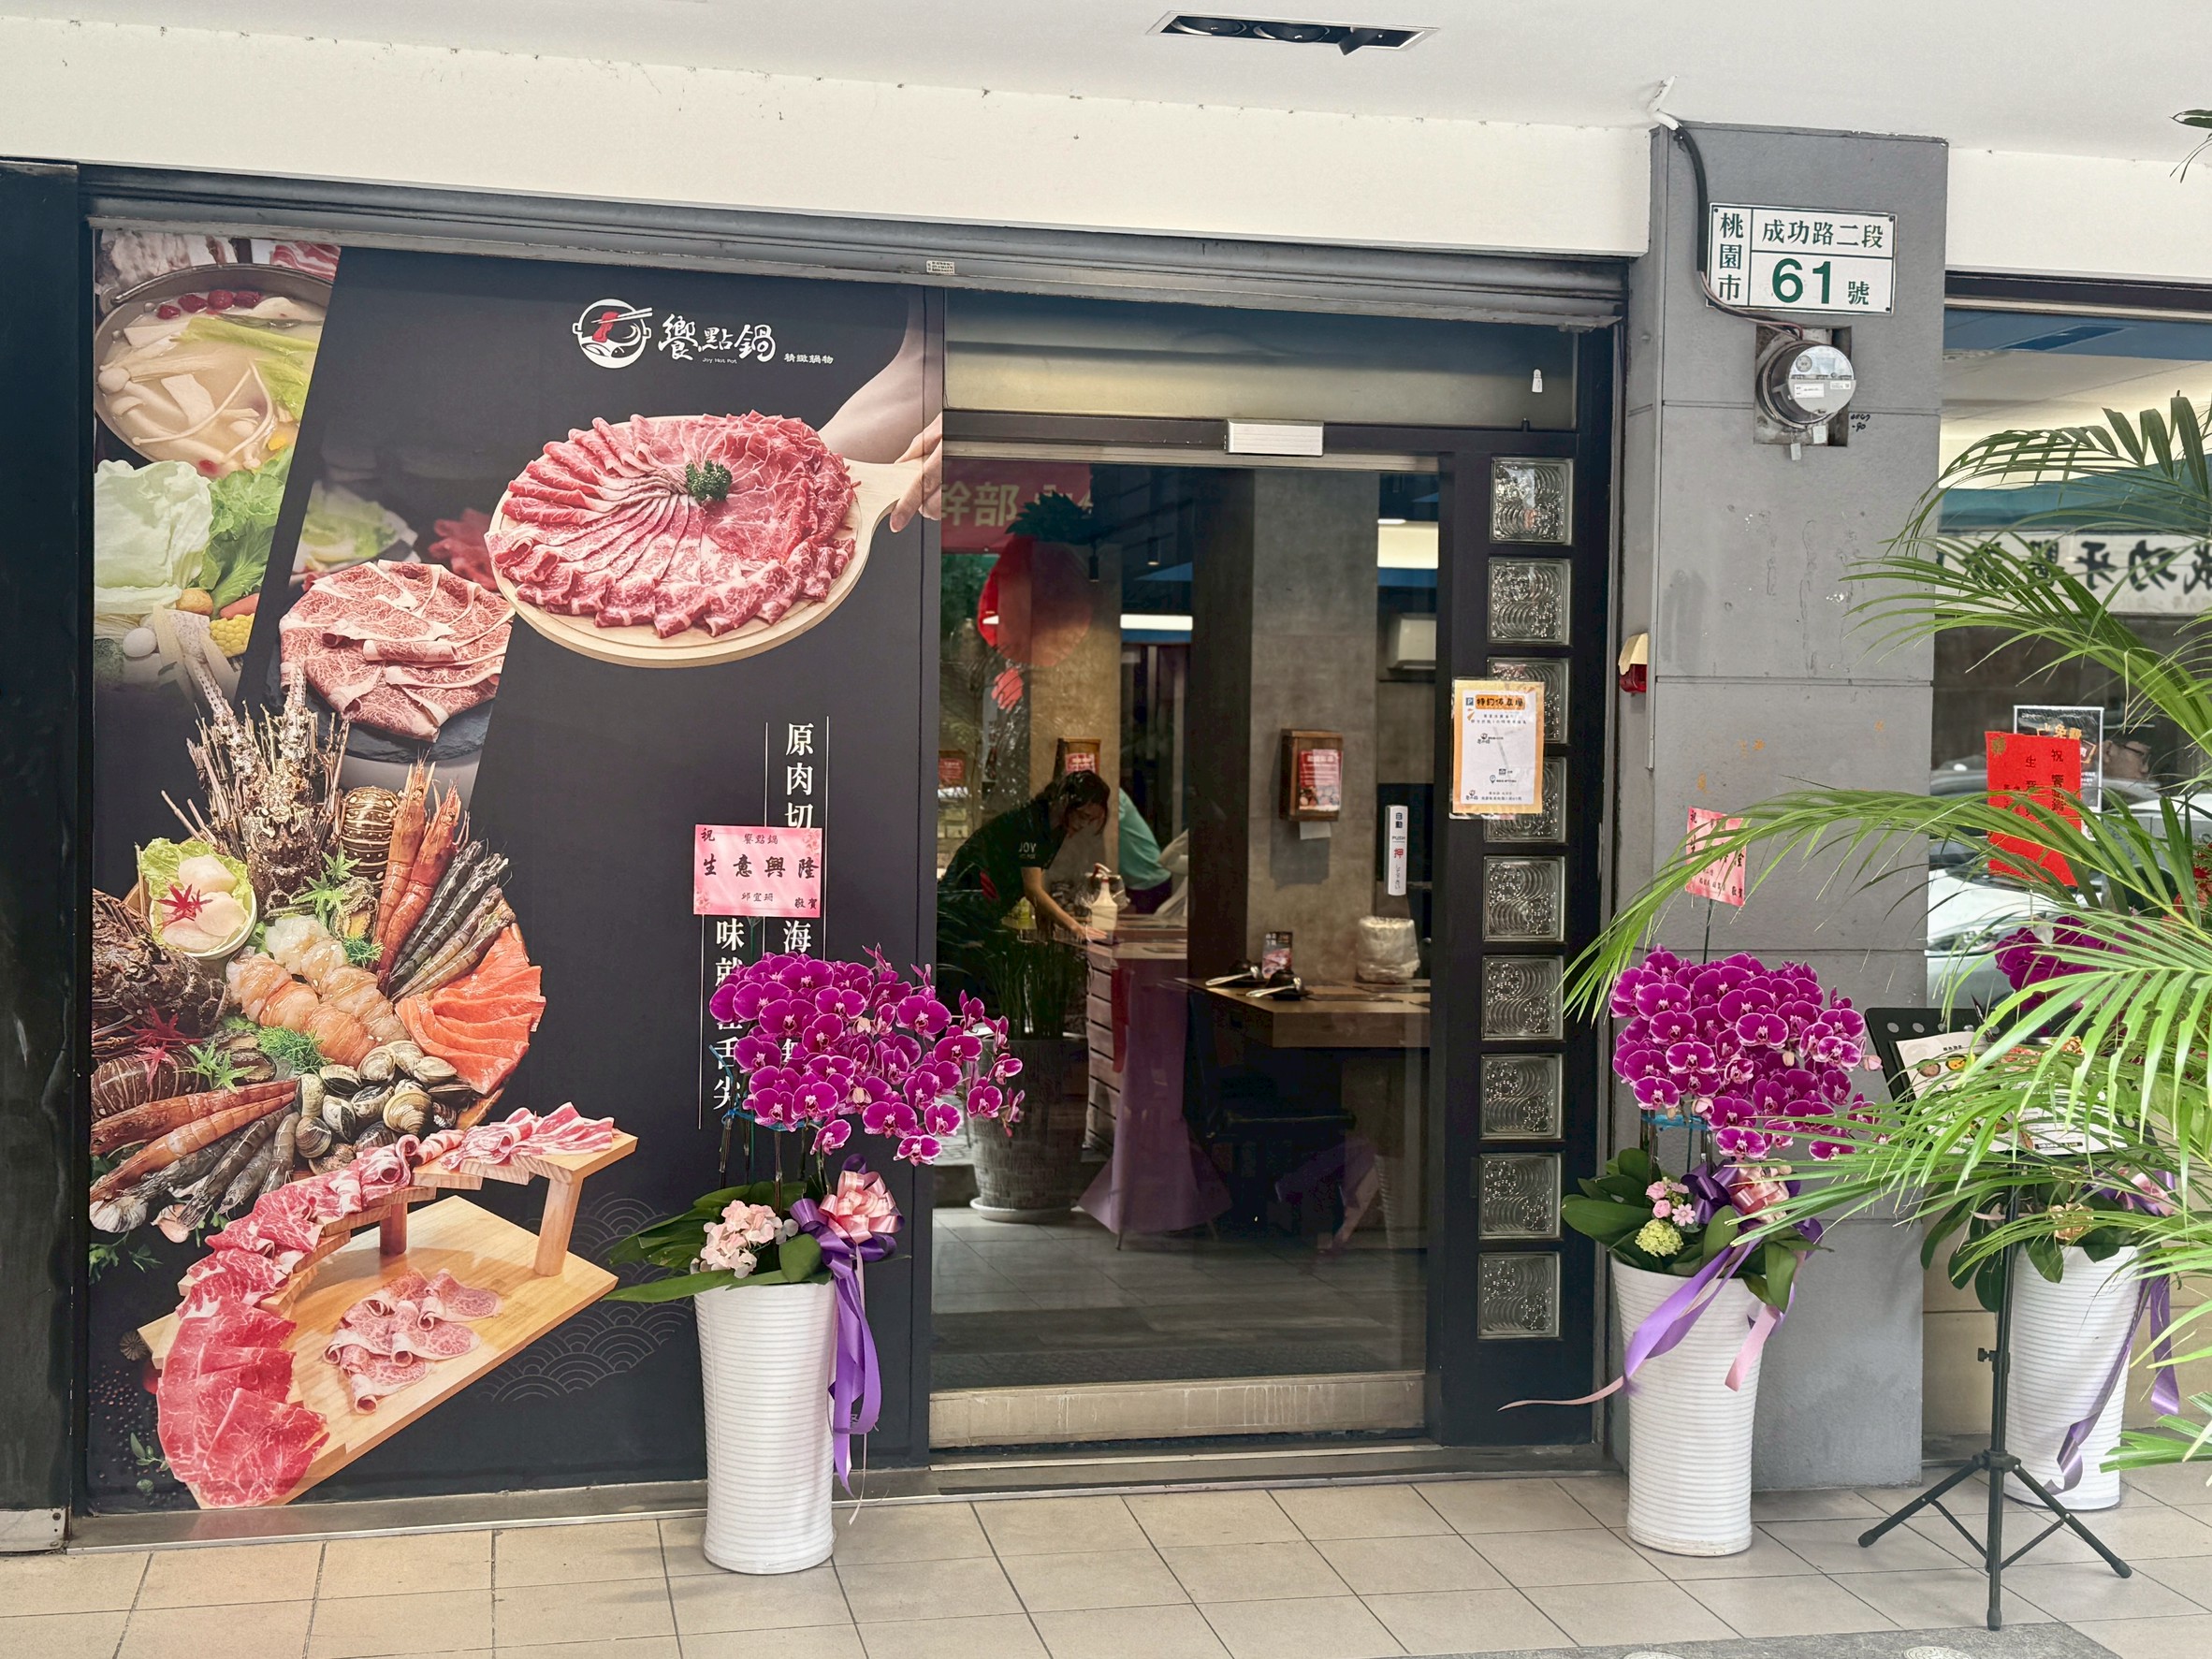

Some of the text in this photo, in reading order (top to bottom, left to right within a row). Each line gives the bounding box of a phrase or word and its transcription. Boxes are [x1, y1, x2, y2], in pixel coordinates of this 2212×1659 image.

[1762, 219, 1884, 249] 成功路二段
[1717, 211, 1744, 301] 桃園市
[1771, 257, 1870, 306] 61 號
[658, 313, 777, 363] 饗點鍋
[701, 827, 716, 842] 祝
[1018, 841, 1037, 853] JOY
[703, 853, 820, 880] 生意興隆
[794, 896, 818, 910] 敬賀
